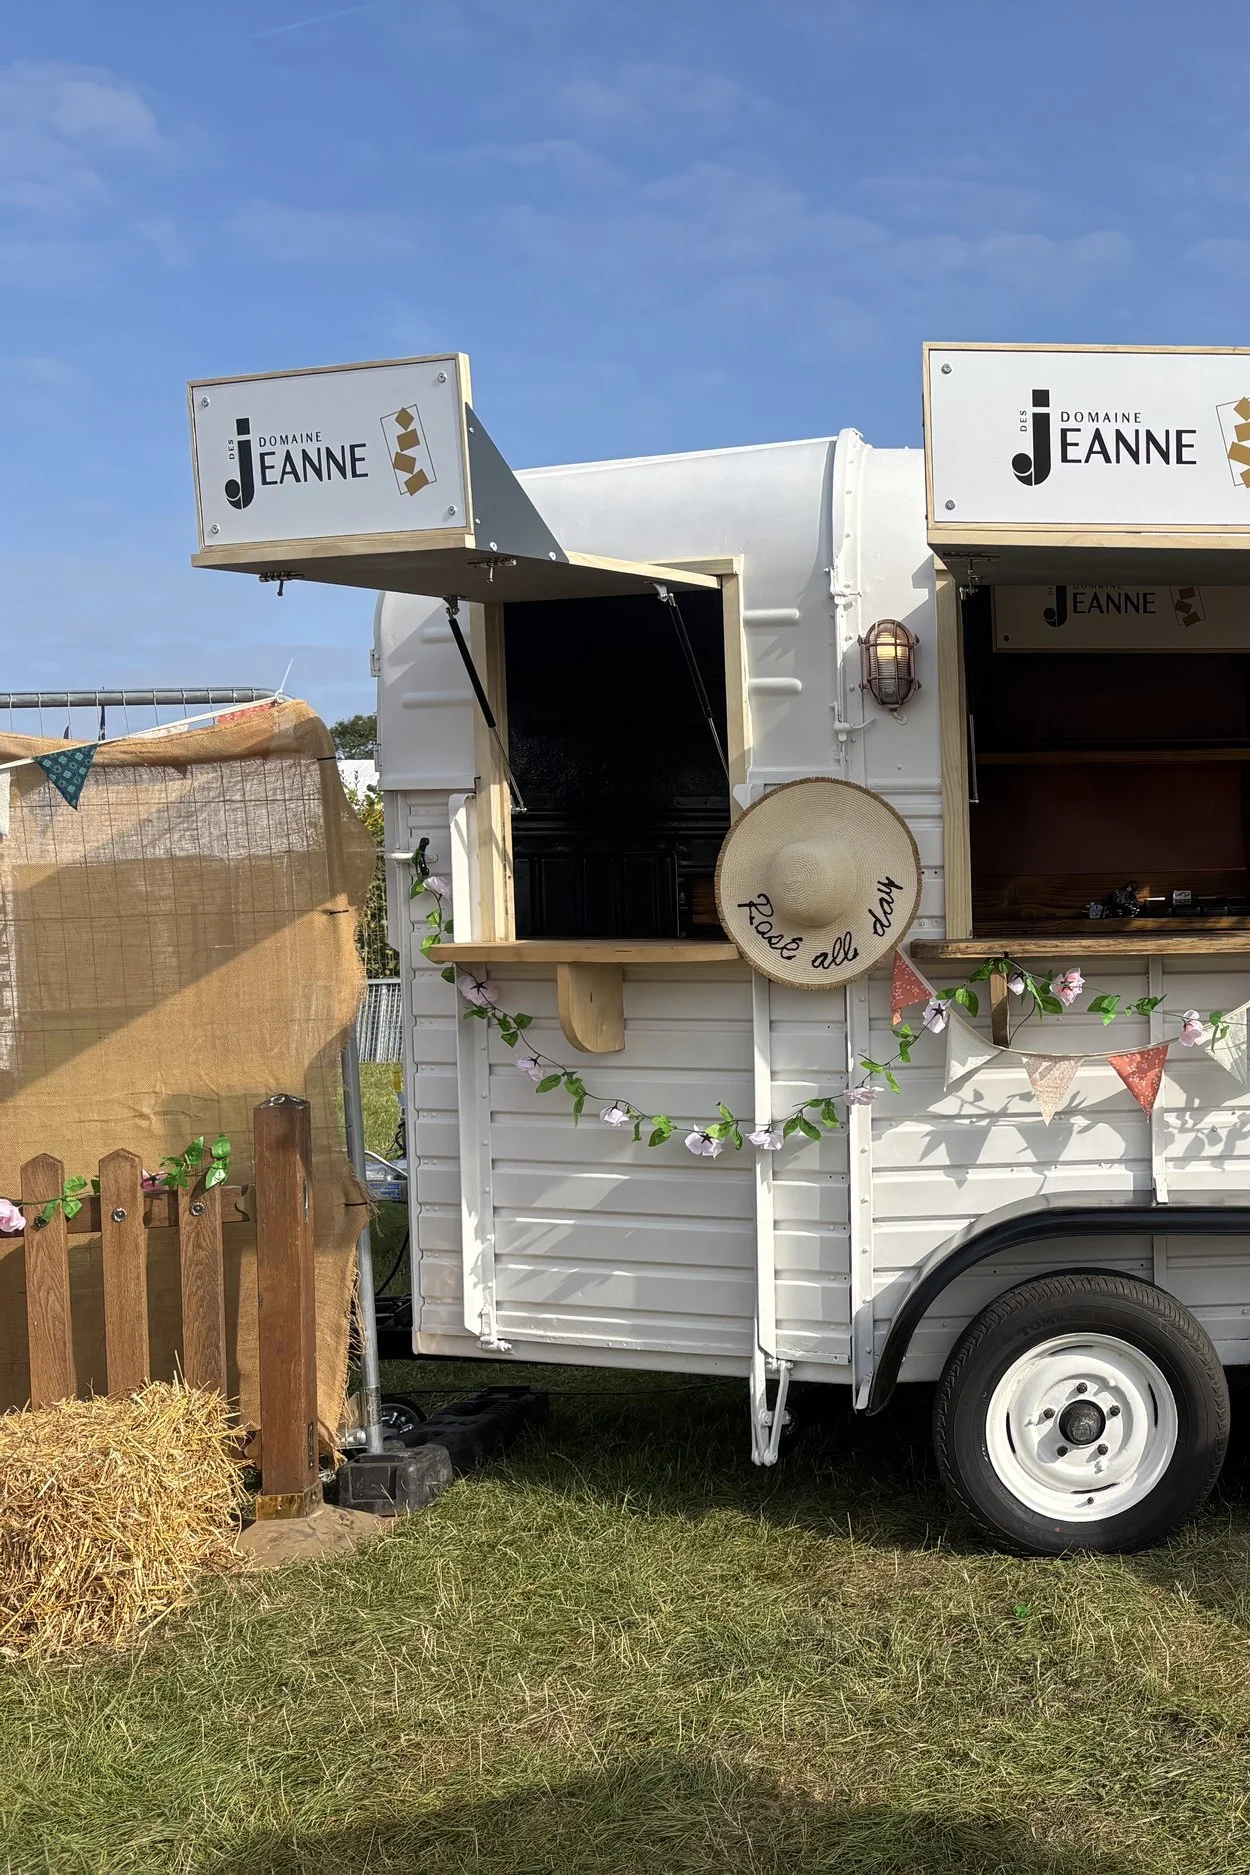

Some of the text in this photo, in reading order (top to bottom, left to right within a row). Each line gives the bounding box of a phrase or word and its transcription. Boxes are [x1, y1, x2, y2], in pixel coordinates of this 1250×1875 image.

[1019, 410, 1027, 432] DES
[1060, 411, 1143, 424] DOMAINE
[227, 439, 235, 460] DES
[258, 431, 322, 448] DOMAINE
[812, 931, 860, 970] all
[868, 876, 904, 937] day
